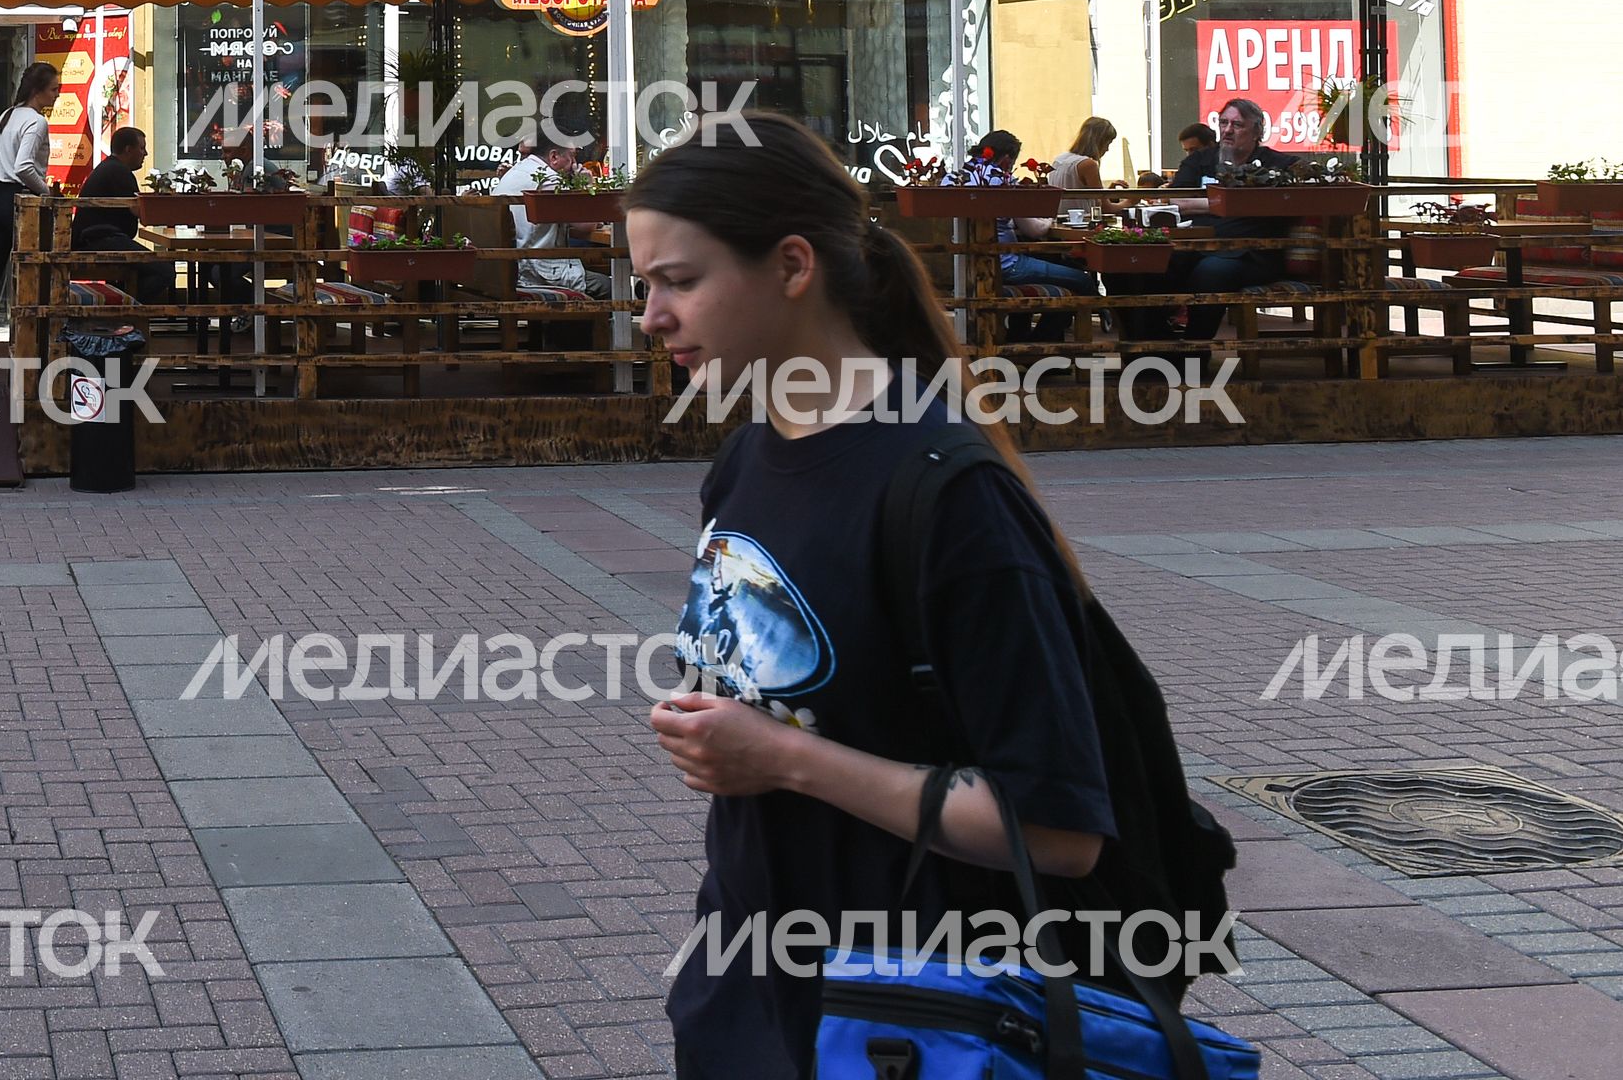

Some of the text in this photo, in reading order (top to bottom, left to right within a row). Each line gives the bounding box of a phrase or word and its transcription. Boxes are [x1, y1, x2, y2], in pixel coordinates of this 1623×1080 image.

[210, 24, 278, 39] ПОПРОУЙ
[236, 59, 253, 68] НА
[1205, 28, 1358, 92] АРЕНД
